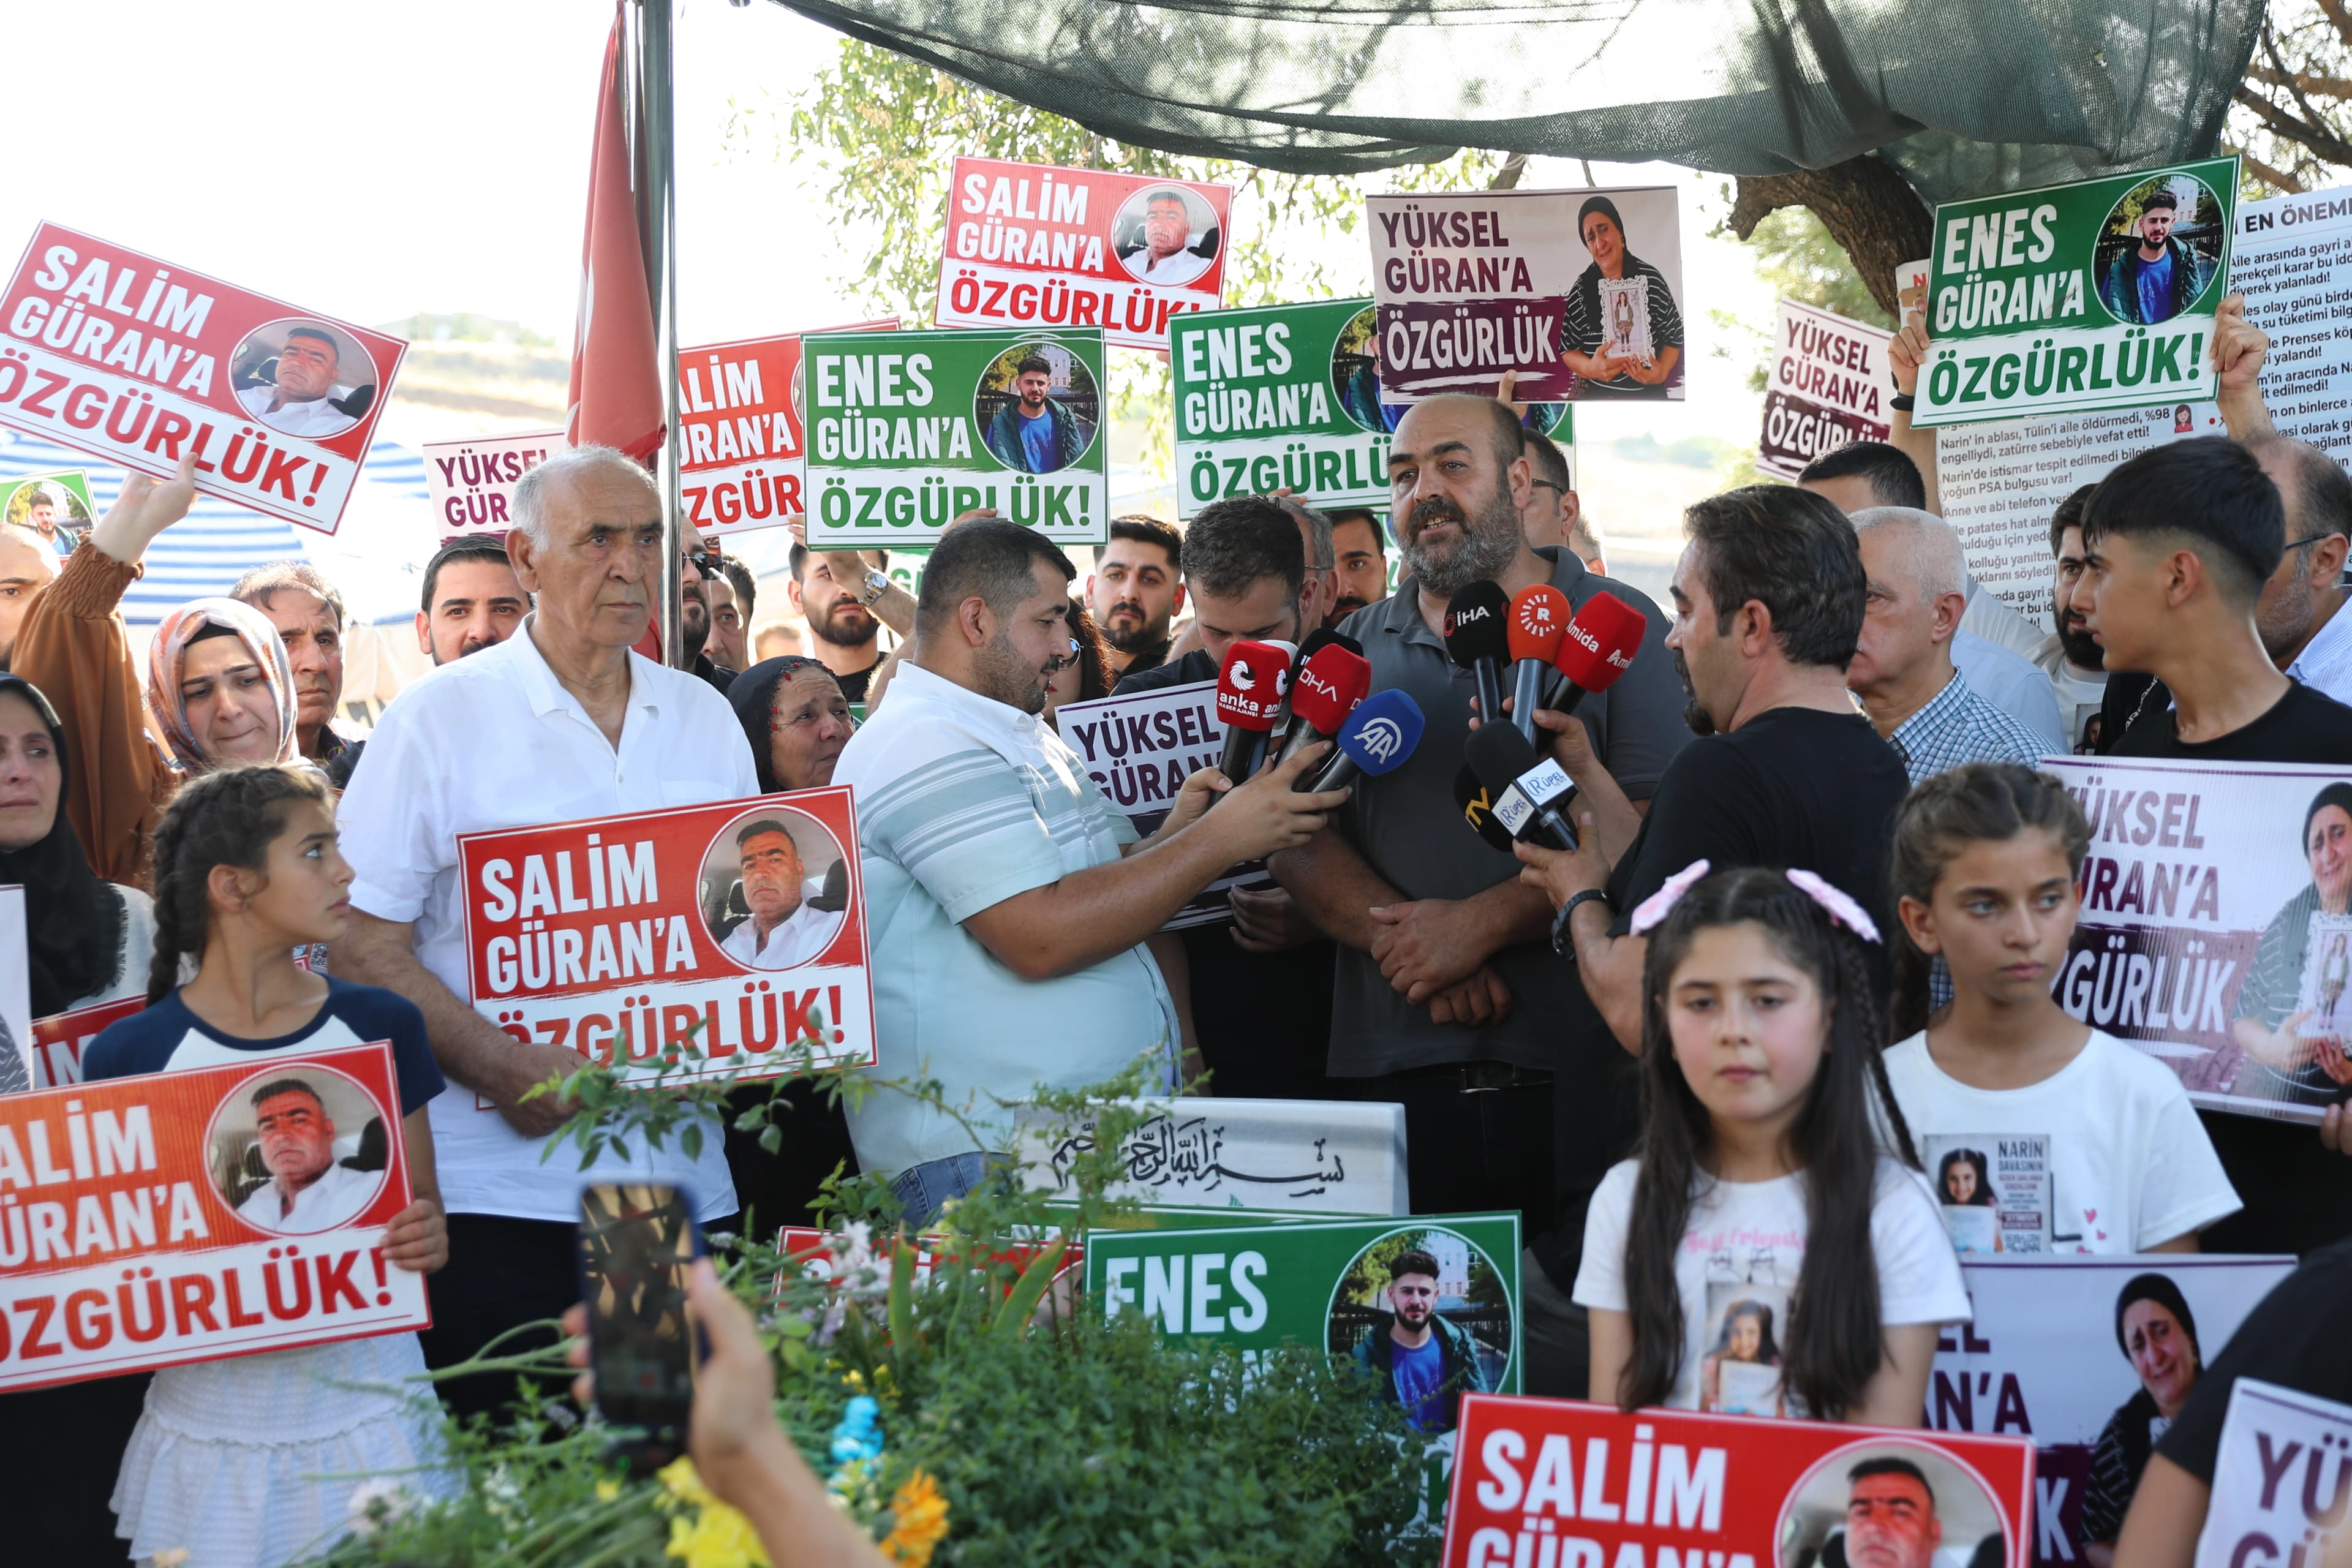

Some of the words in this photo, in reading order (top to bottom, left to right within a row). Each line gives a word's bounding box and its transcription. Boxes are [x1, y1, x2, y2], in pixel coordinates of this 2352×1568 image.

[962, 173, 1089, 225] SALİM
[1378, 204, 1509, 248] YÜKSEL
[1942, 203, 2057, 276] ENES
[2245, 212, 2274, 233] EN
[956, 217, 1104, 273] GÜRAN'A
[2254, 246, 2306, 264] arasında
[2309, 237, 2340, 257] gayri
[34, 244, 215, 339] SALİM
[1384, 250, 1533, 294] GÜRAN'A
[2230, 263, 2281, 286] gerekçeli
[2284, 260, 2315, 273] karar
[2317, 257, 2332, 268] bu
[2274, 271, 2331, 293] yalanladı!
[1935, 269, 2085, 333] GÜRAN'A
[2262, 318, 2275, 329] su
[2278, 307, 2328, 325] tüketimi
[2263, 301, 2288, 313] olay
[2291, 293, 2322, 312] günü
[10, 296, 216, 398] GÜRAN'A
[1181, 322, 1292, 383] ENES
[1387, 305, 1557, 372] ÖZGÜRLÜK
[1787, 317, 1871, 376] YÜKSEL
[2274, 345, 2322, 366] yalandı!
[2282, 331, 2331, 347] Prenses
[816, 353, 934, 408] ENES
[1779, 354, 1879, 418] GÜRAN'A
[1929, 328, 2204, 407] ÖZGÜRLÜK!
[2285, 364, 2338, 383] aracında
[1184, 382, 1332, 435] GÜRAN'A
[2272, 379, 2329, 398] edilmedi!
[2280, 406, 2296, 417] on
[2299, 399, 2348, 415] binlerce
[0, 348, 330, 508] ÖZGÜRLÜK!
[680, 411, 796, 467] RAN'A
[817, 409, 973, 461] GÜRAN'A
[1988, 431, 2022, 443] ablası,
[2024, 423, 2057, 439] Tülin'i
[2060, 421, 2079, 434] aile
[2082, 411, 2143, 431] öldürmedi,
[2145, 407, 2170, 422] %98
[2301, 419, 2339, 435] olarak
[1941, 447, 1996, 466] engelliydi,
[1999, 443, 2038, 457] zatürre
[2040, 434, 2093, 451] sebebiyle
[2096, 430, 2124, 443] vefat
[2127, 426, 2150, 440] etti!
[1190, 436, 1392, 502] ÖZGÜRLÜ
[1942, 468, 1987, 484] Narin'de
[1990, 464, 2034, 478] istismar
[2037, 456, 2067, 473] tespit
[2070, 450, 2118, 468] edilmedi
[1942, 486, 1976, 501] yoğun
[1979, 481, 2002, 494] PSA
[2005, 478, 2049, 491] bulgusu
[2051, 472, 2073, 484] var!
[1944, 506, 1971, 518] Anne
[1973, 505, 1986, 514] ve
[1989, 501, 2006, 513] abi
[2008, 496, 2047, 510] telefon
[1967, 521, 2008, 537] patates
[2010, 518, 2028, 530] hat
[2004, 532, 2024, 548] için
[1969, 555, 2008, 570] kolluğu
[2018, 586, 2045, 602] gayri
[2027, 603, 2041, 614] bu
[1457, 605, 1490, 627] İHA
[1566, 617, 1600, 654] Amida
[1219, 692, 1259, 712] anka
[1298, 667, 1337, 703] DHA
[1218, 701, 1236, 712] HABER
[1264, 698, 1283, 714] ank
[1072, 710, 1221, 763] YÜKSEL
[1353, 725, 1395, 765] AA
[480, 832, 658, 923] SALİM
[2082, 845, 2220, 922] RAN'A
[486, 914, 698, 994] GÜRAN'A
[2049, 935, 2236, 1033] GÜRLÜK
[0, 1098, 158, 1193] ALİM
[1998, 1137, 2043, 1158] NARİN
[0, 1181, 210, 1267] ÜRAN'A
[0, 1243, 392, 1364] ZGÜRLÜK!
[1104, 1250, 1268, 1335] ENES
[1476, 1423, 1727, 1532] SALİM
